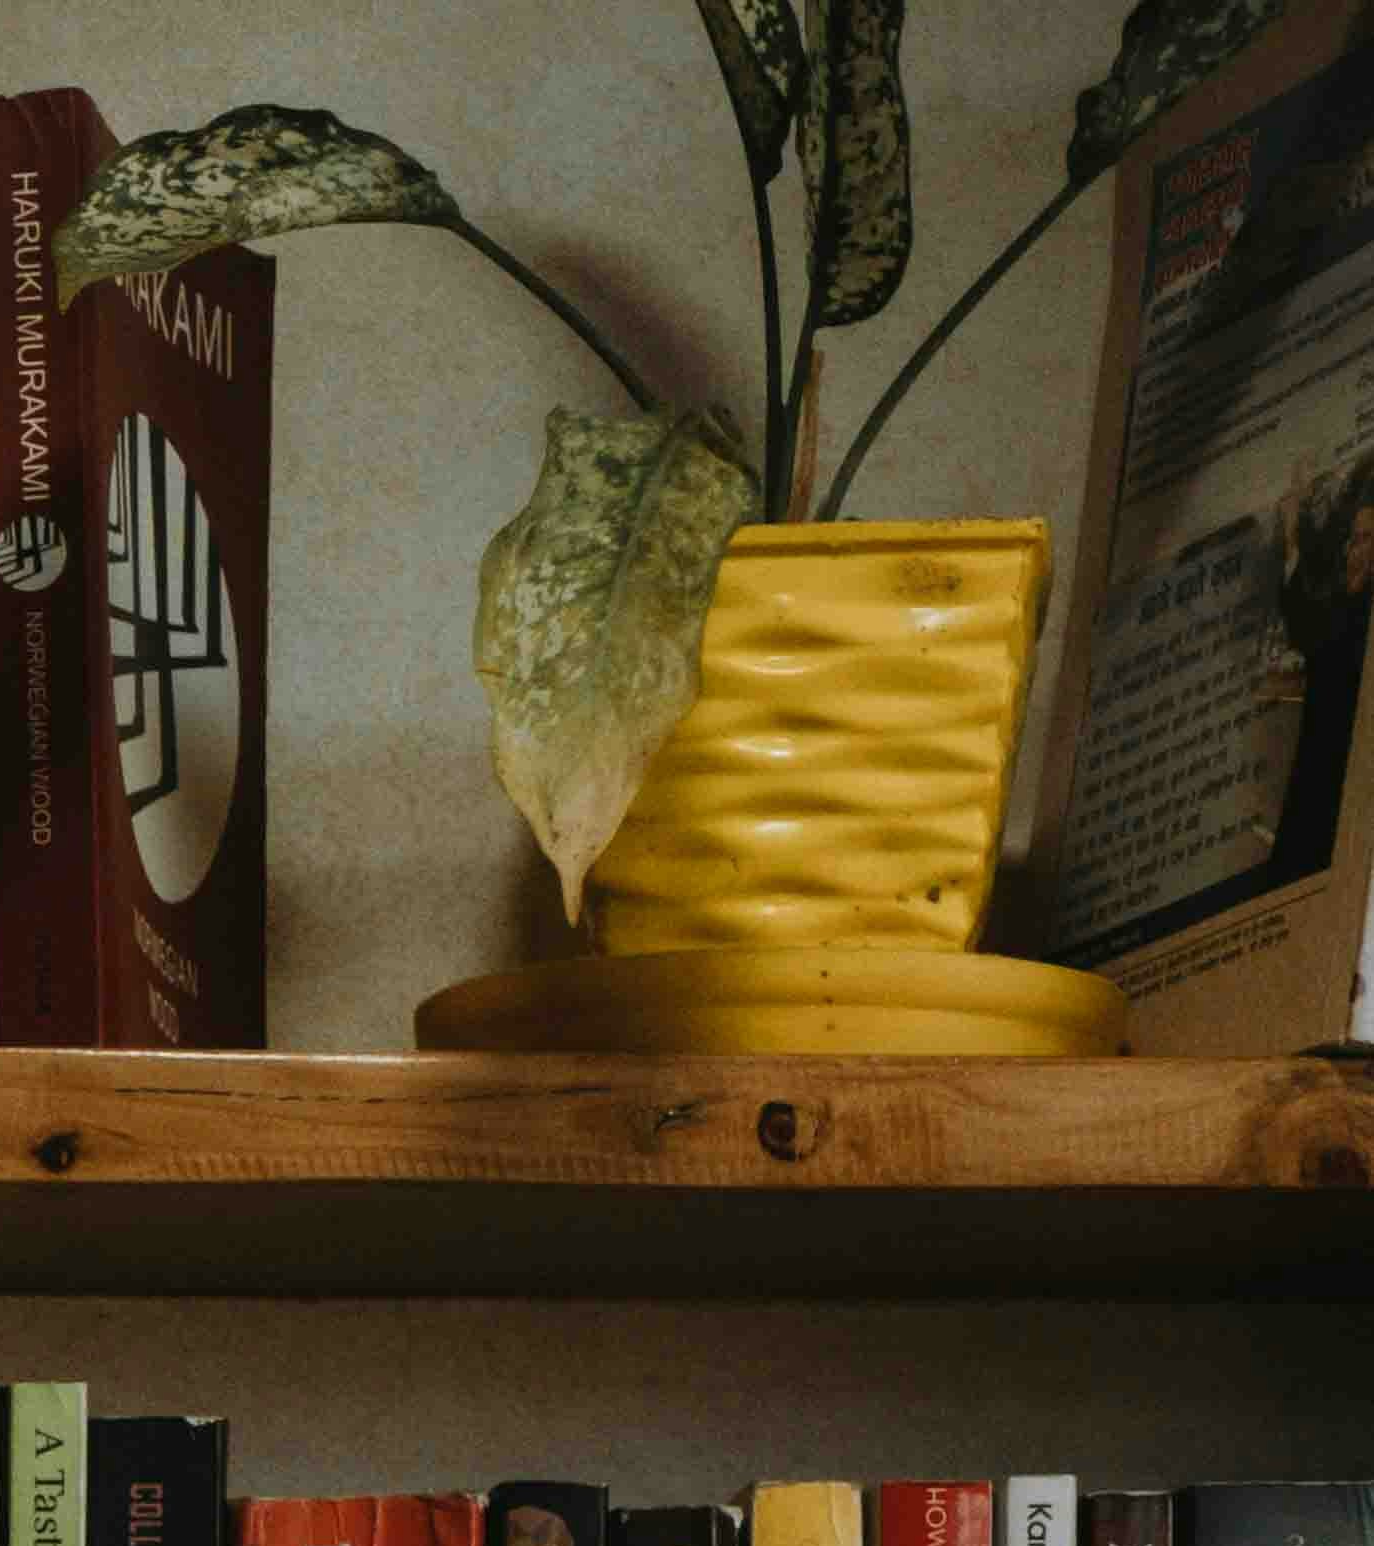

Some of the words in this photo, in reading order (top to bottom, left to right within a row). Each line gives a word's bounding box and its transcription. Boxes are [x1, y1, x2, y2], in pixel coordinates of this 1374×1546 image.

[10, 170, 41, 302] HARUKI
[15, 312, 50, 502] MURAKAMI
[34, 1428, 64, 1456] A
